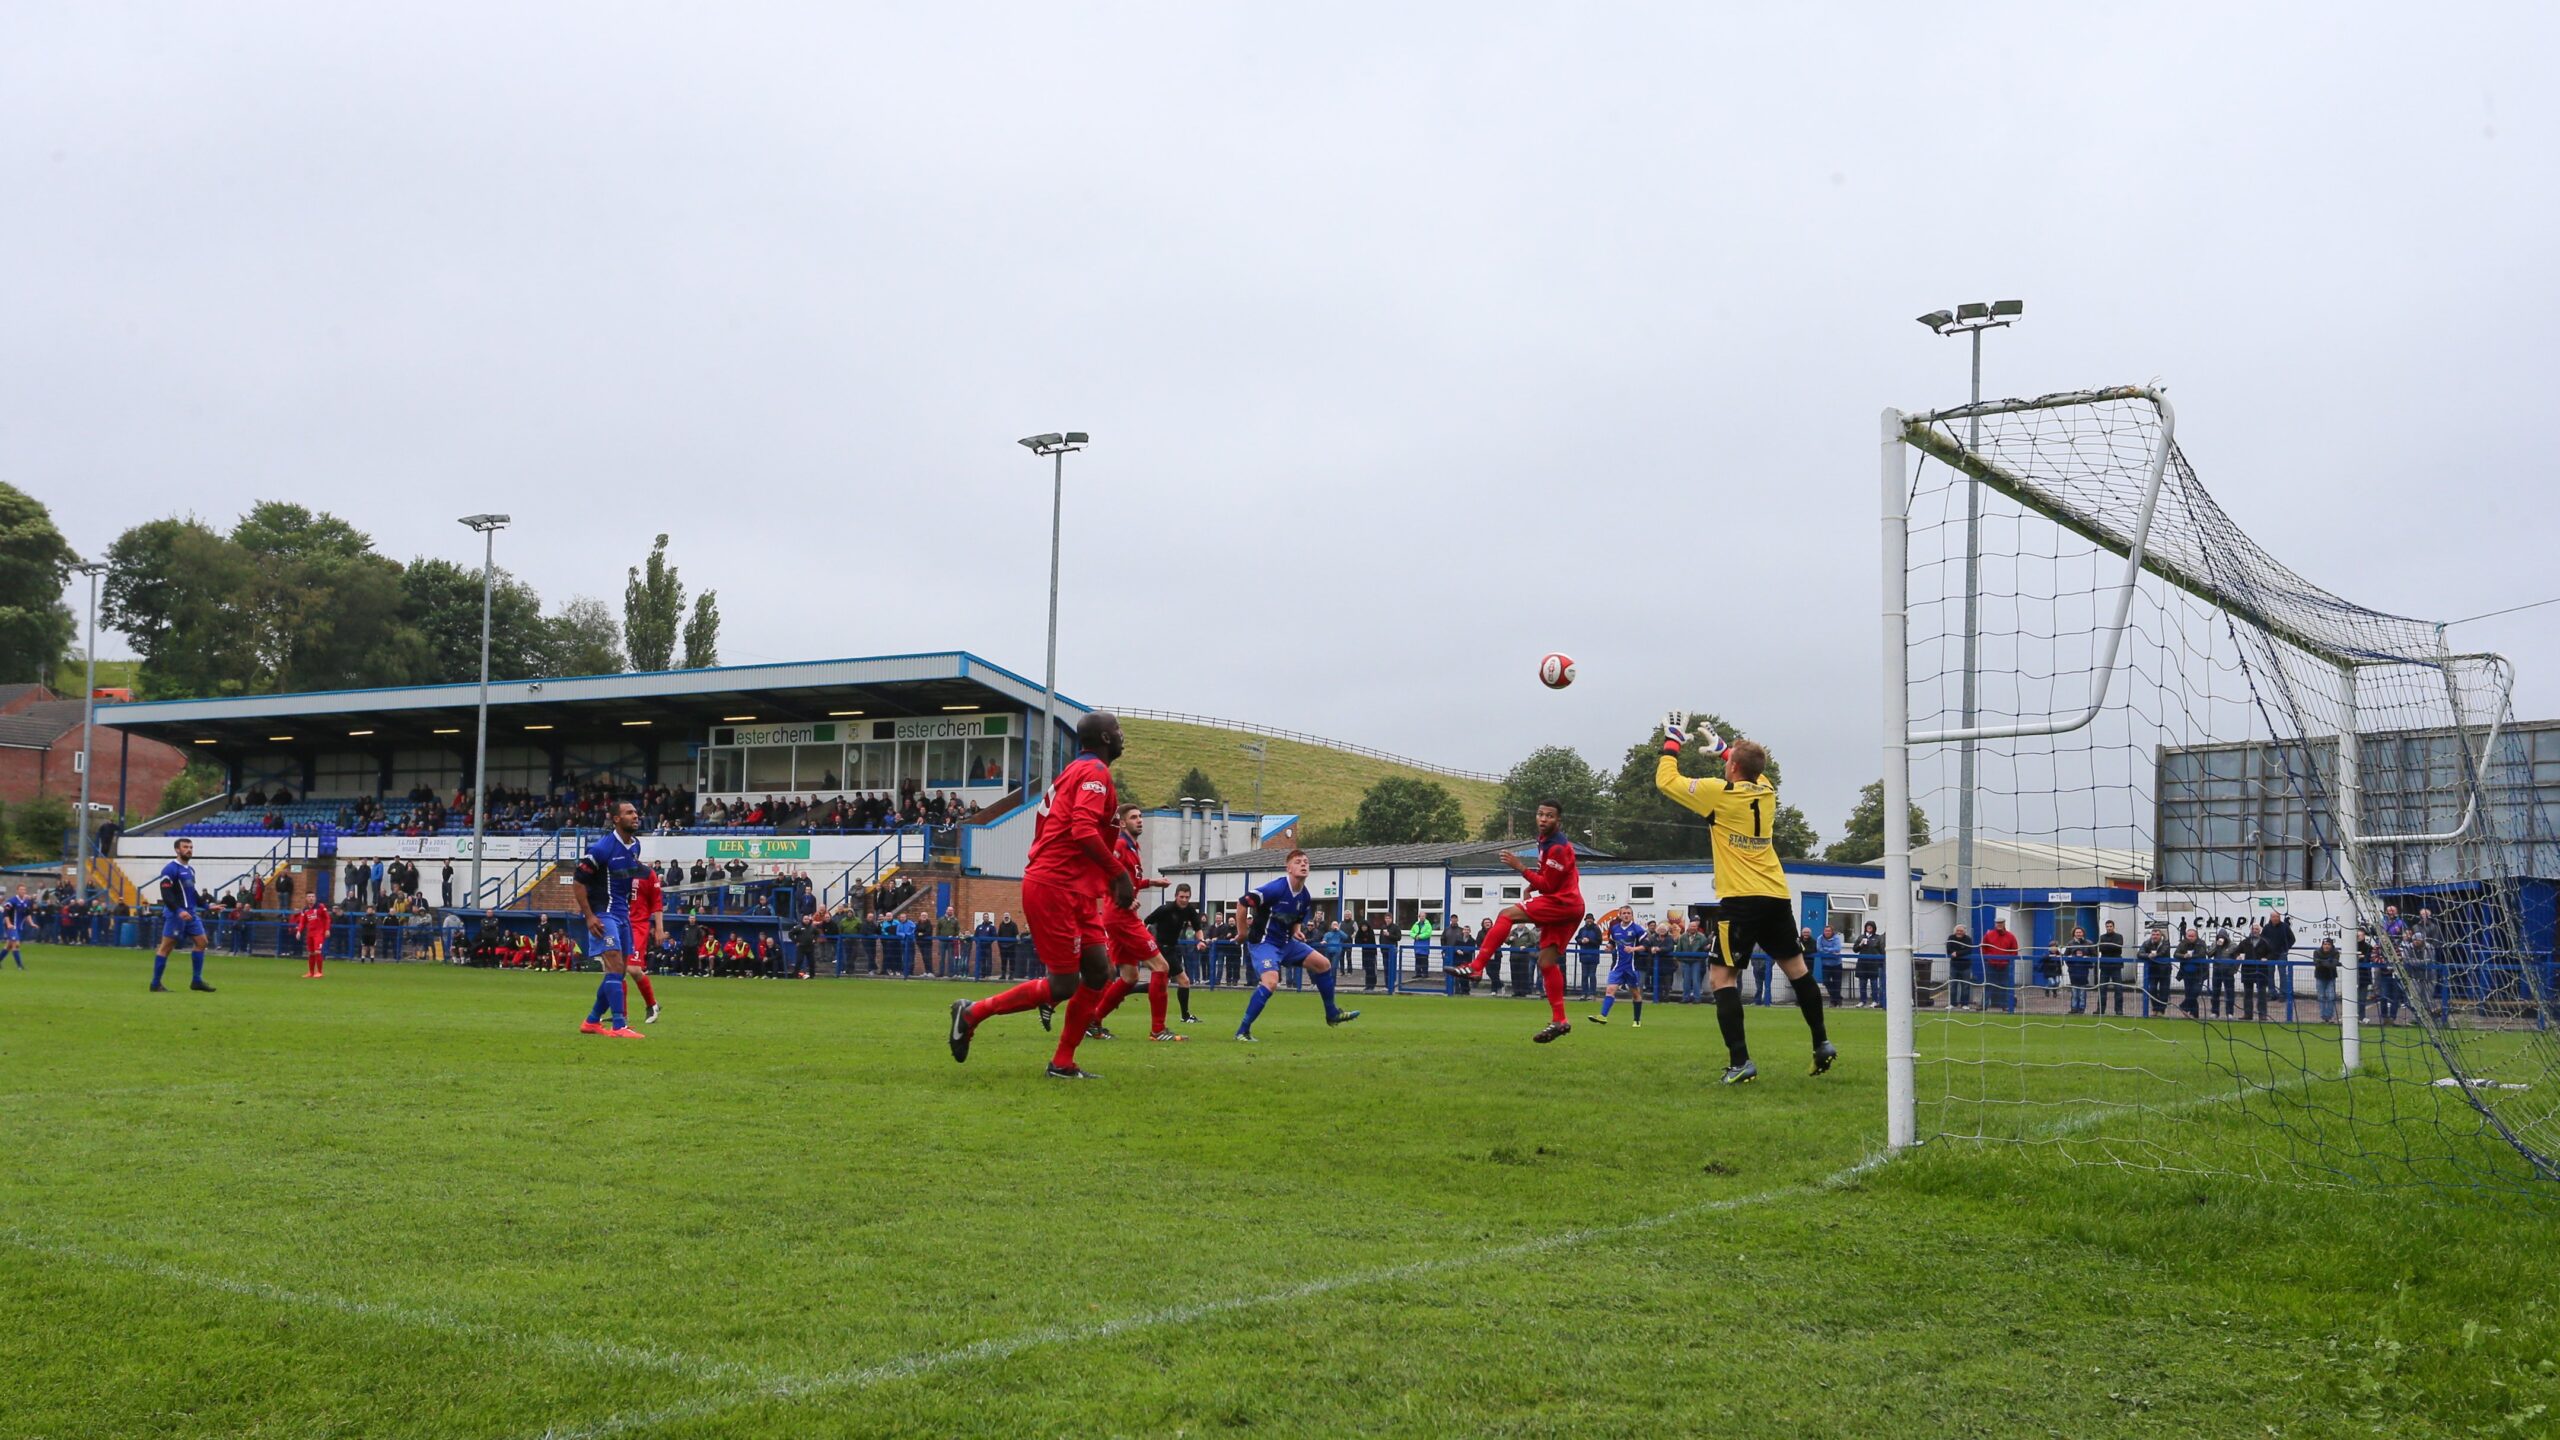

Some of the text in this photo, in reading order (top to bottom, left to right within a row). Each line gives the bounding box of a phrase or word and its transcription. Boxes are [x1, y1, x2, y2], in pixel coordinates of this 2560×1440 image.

[1749, 798, 1761, 837] 1
[1728, 833, 1748, 844] STAN
[719, 840, 797, 852] LEEK TOWN
[2298, 926, 2308, 934] AT
